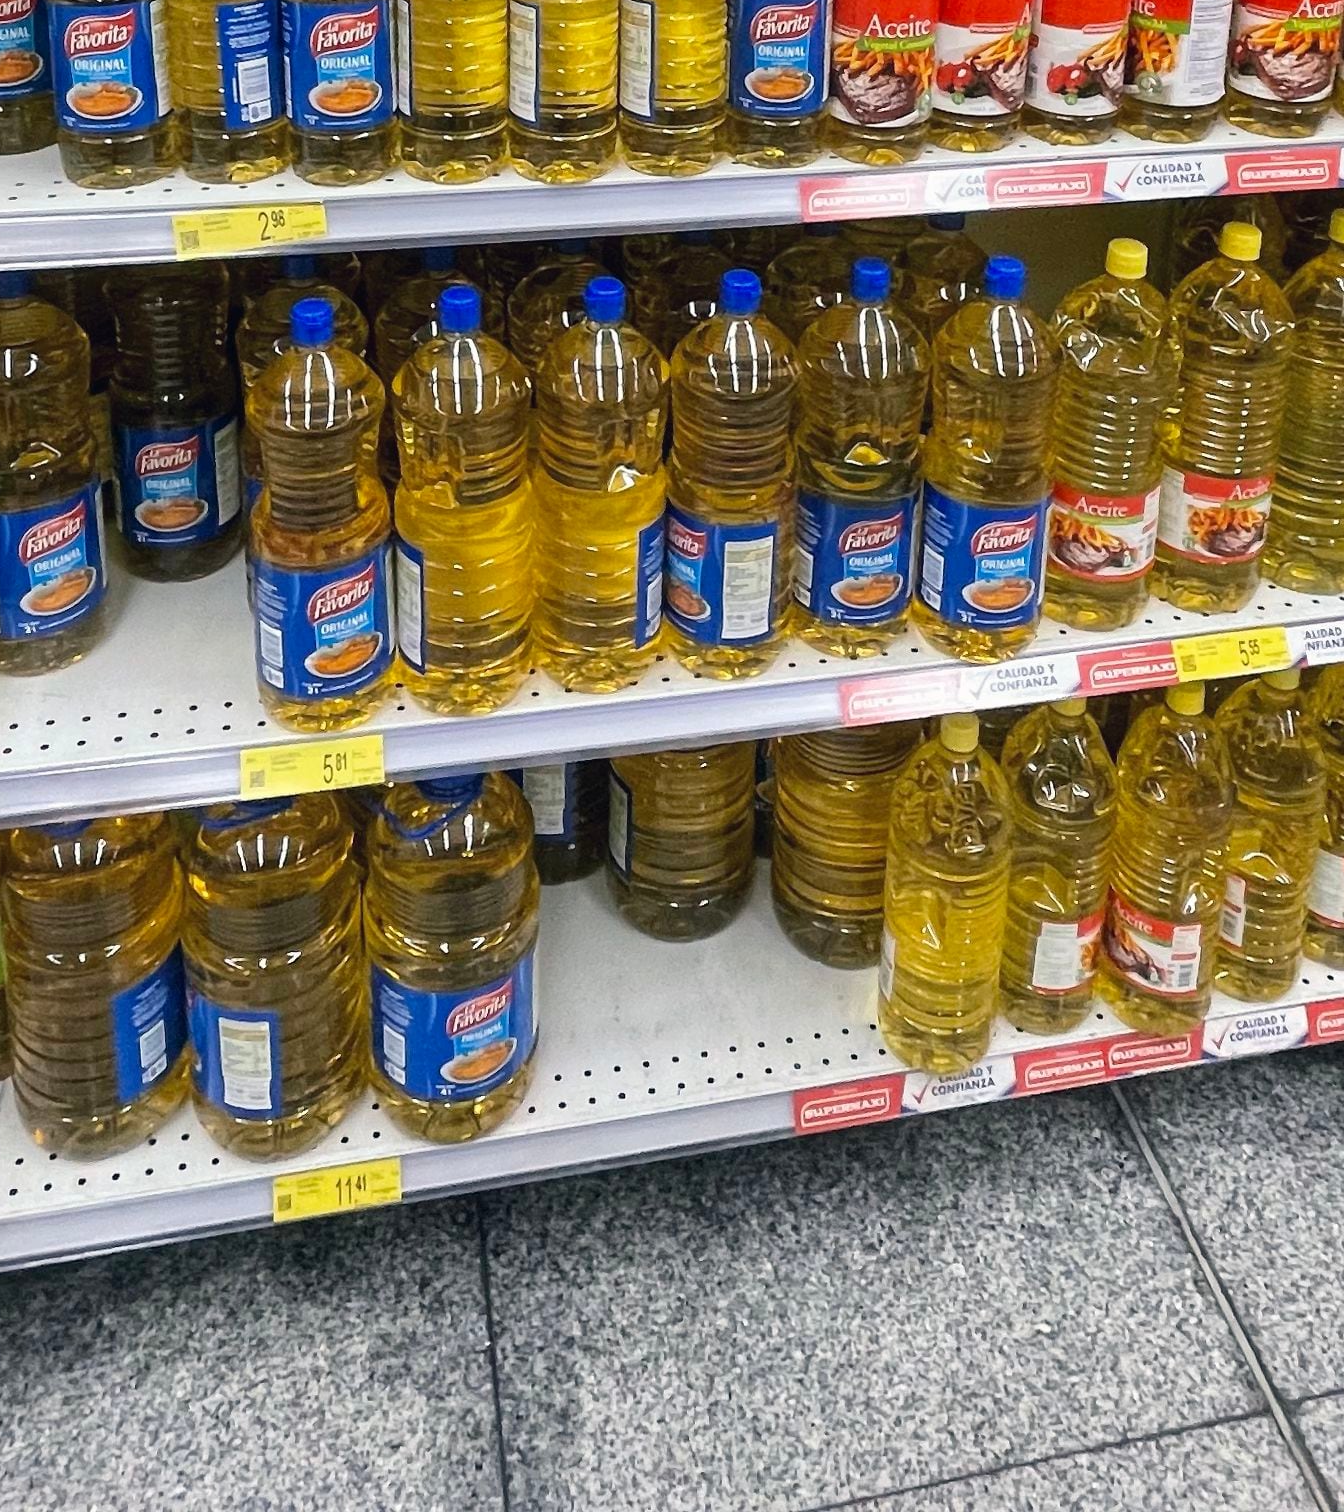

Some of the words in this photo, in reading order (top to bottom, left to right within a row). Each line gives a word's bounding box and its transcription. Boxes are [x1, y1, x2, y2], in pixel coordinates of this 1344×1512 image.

[755, 14, 812, 43] Favorita
[864, 13, 931, 39] Aceite
[69, 26, 129, 55] Favorita
[316, 24, 374, 53] Favorita
[757, 45, 806, 58] ORIGINAL
[74, 59, 128, 73] ORIGINAL
[320, 56, 372, 70] ORIGINAL
[1136, 172, 1205, 186] CONFIANZA
[1143, 163, 1193, 175] CALIDAD
[1196, 162, 1203, 172] Y
[1241, 166, 1326, 181] SUPERMAXI
[997, 181, 1089, 196] SUPERMAXI
[140, 449, 192, 475] Favorita
[1074, 496, 1128, 518] Aceite
[24, 514, 82, 559] Favorita
[844, 525, 899, 552] Favorita
[976, 527, 1031, 553] Favorita
[33, 547, 82, 575] ORIGINAL
[980, 557, 1026, 569] ORIGINAL
[313, 580, 370, 620] Favorita
[320, 611, 369, 635] ORIGINAL
[996, 665, 1046, 680] CALIDAD
[1048, 663, 1056, 674] Y
[989, 675, 1058, 693] CONFIANZA
[452, 995, 509, 1033] Favorita
[1235, 1015, 1276, 1030] CALIDAD
[1279, 1013, 1287, 1025] Y
[1229, 1025, 1290, 1042] CONFIANZA
[1114, 1039, 1188, 1063] SUPERMAXI
[1029, 1059, 1105, 1081] SUPERMAXI
[804, 1096, 886, 1119] SUPERMAXI
